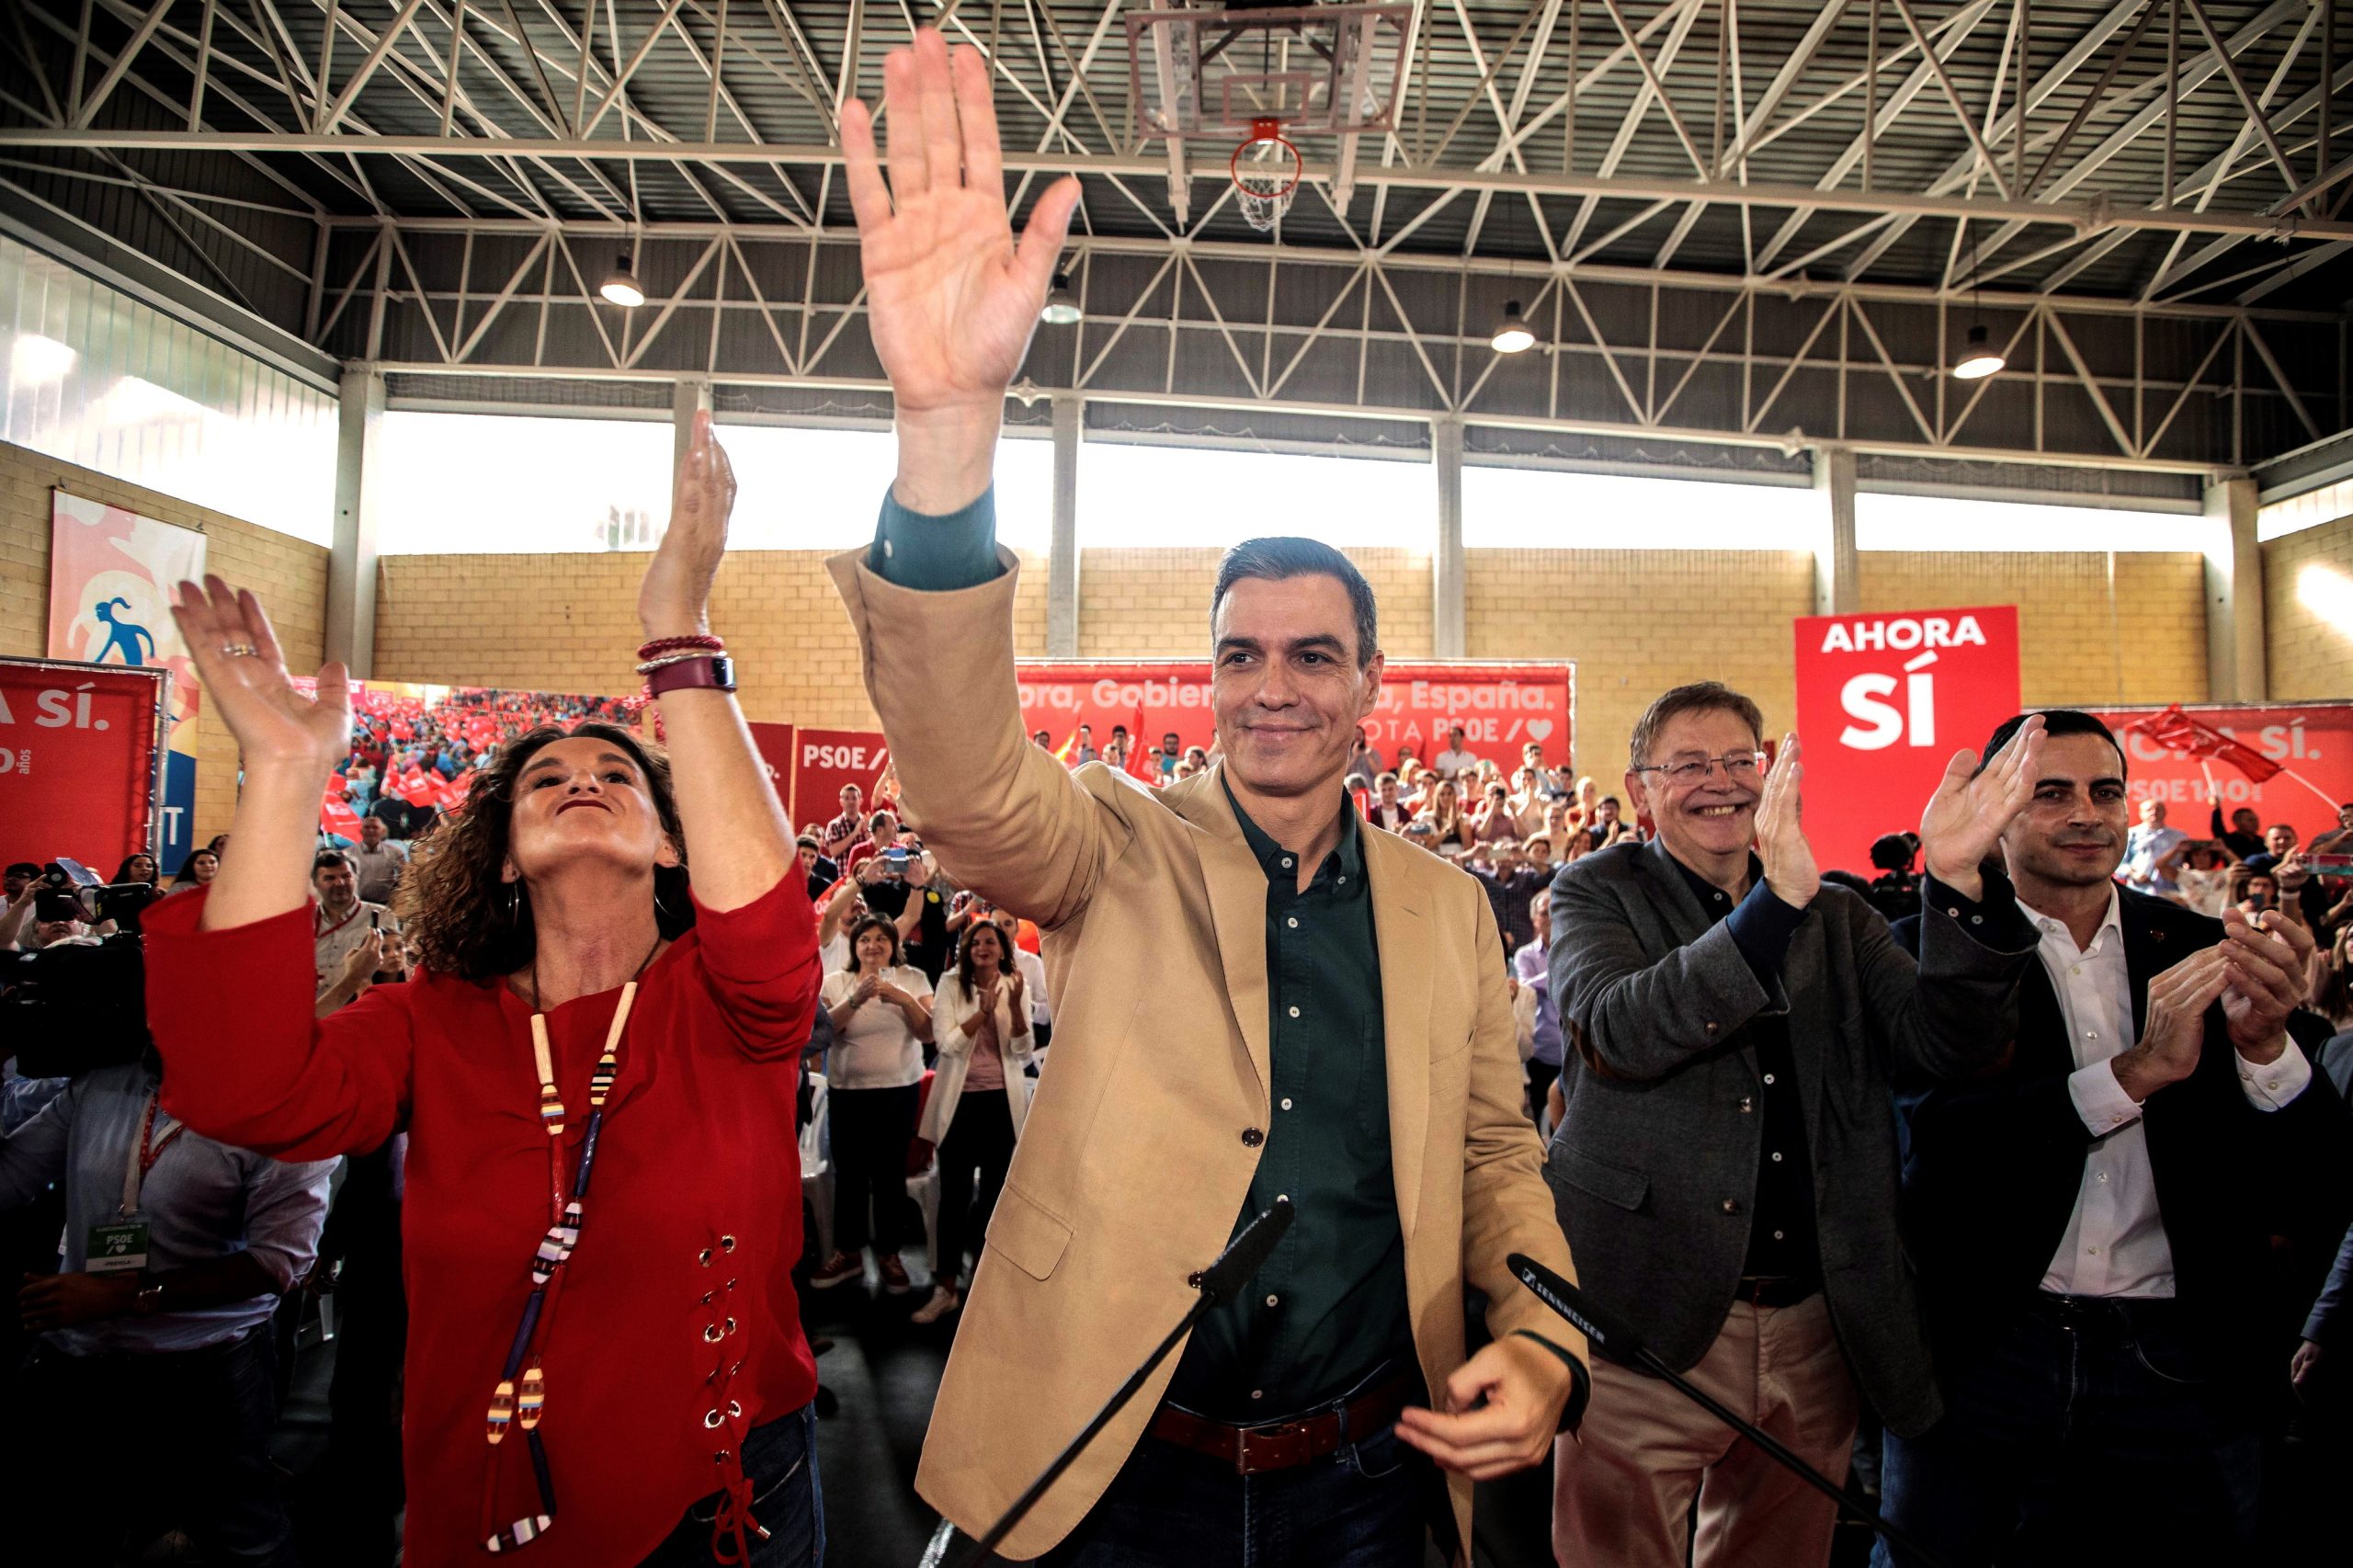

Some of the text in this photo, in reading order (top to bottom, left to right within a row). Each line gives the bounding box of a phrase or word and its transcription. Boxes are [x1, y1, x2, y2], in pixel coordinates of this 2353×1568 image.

[1821, 616, 1986, 653] AHORA
[34, 681, 110, 732] SÍ.
[1019, 685, 1083, 714] ora,
[1092, 676, 1213, 709] Gobier
[1412, 680, 1555, 715] España.
[1839, 649, 1938, 750] SÍ
[1363, 720, 1424, 742] OTA
[2260, 717, 2322, 761] SÍ.
